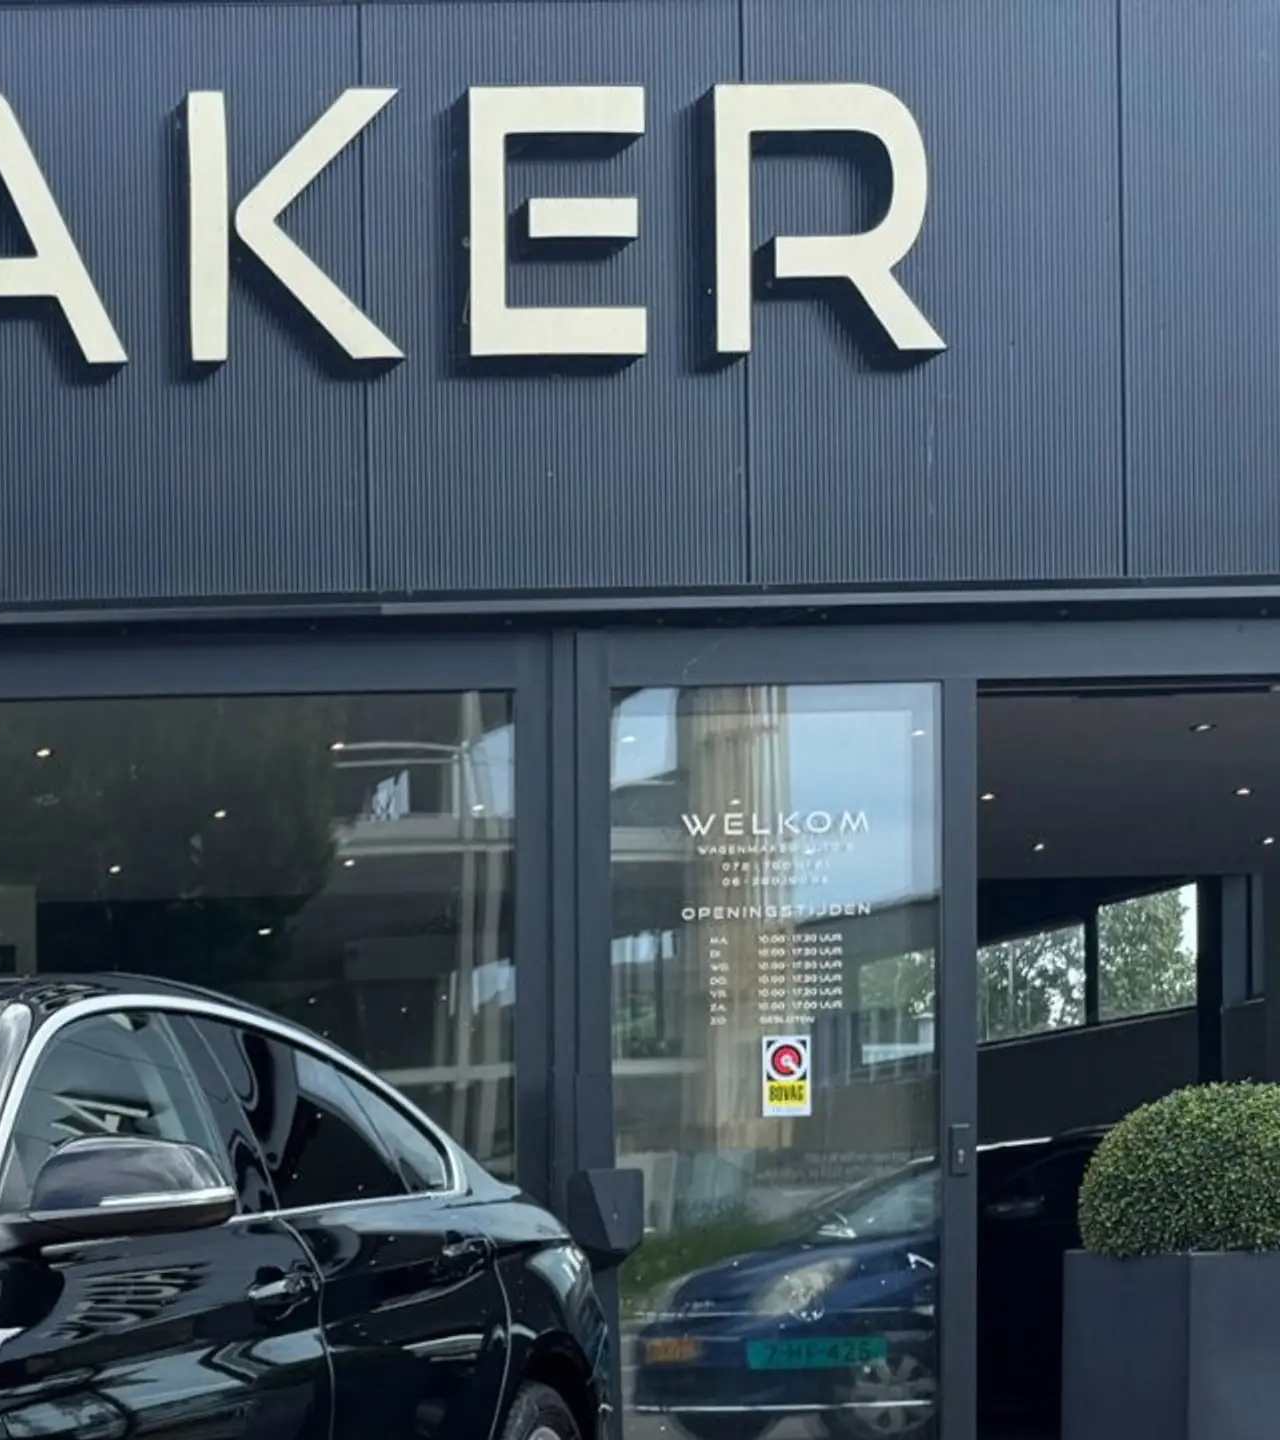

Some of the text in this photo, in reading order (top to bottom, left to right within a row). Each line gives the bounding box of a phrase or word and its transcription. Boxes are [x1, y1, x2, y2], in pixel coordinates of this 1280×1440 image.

[680, 810, 869, 836] WELKOM
[680, 902, 871, 922] OPENINGSTIJDEN
[769, 1084, 804, 1102] BOVAG
